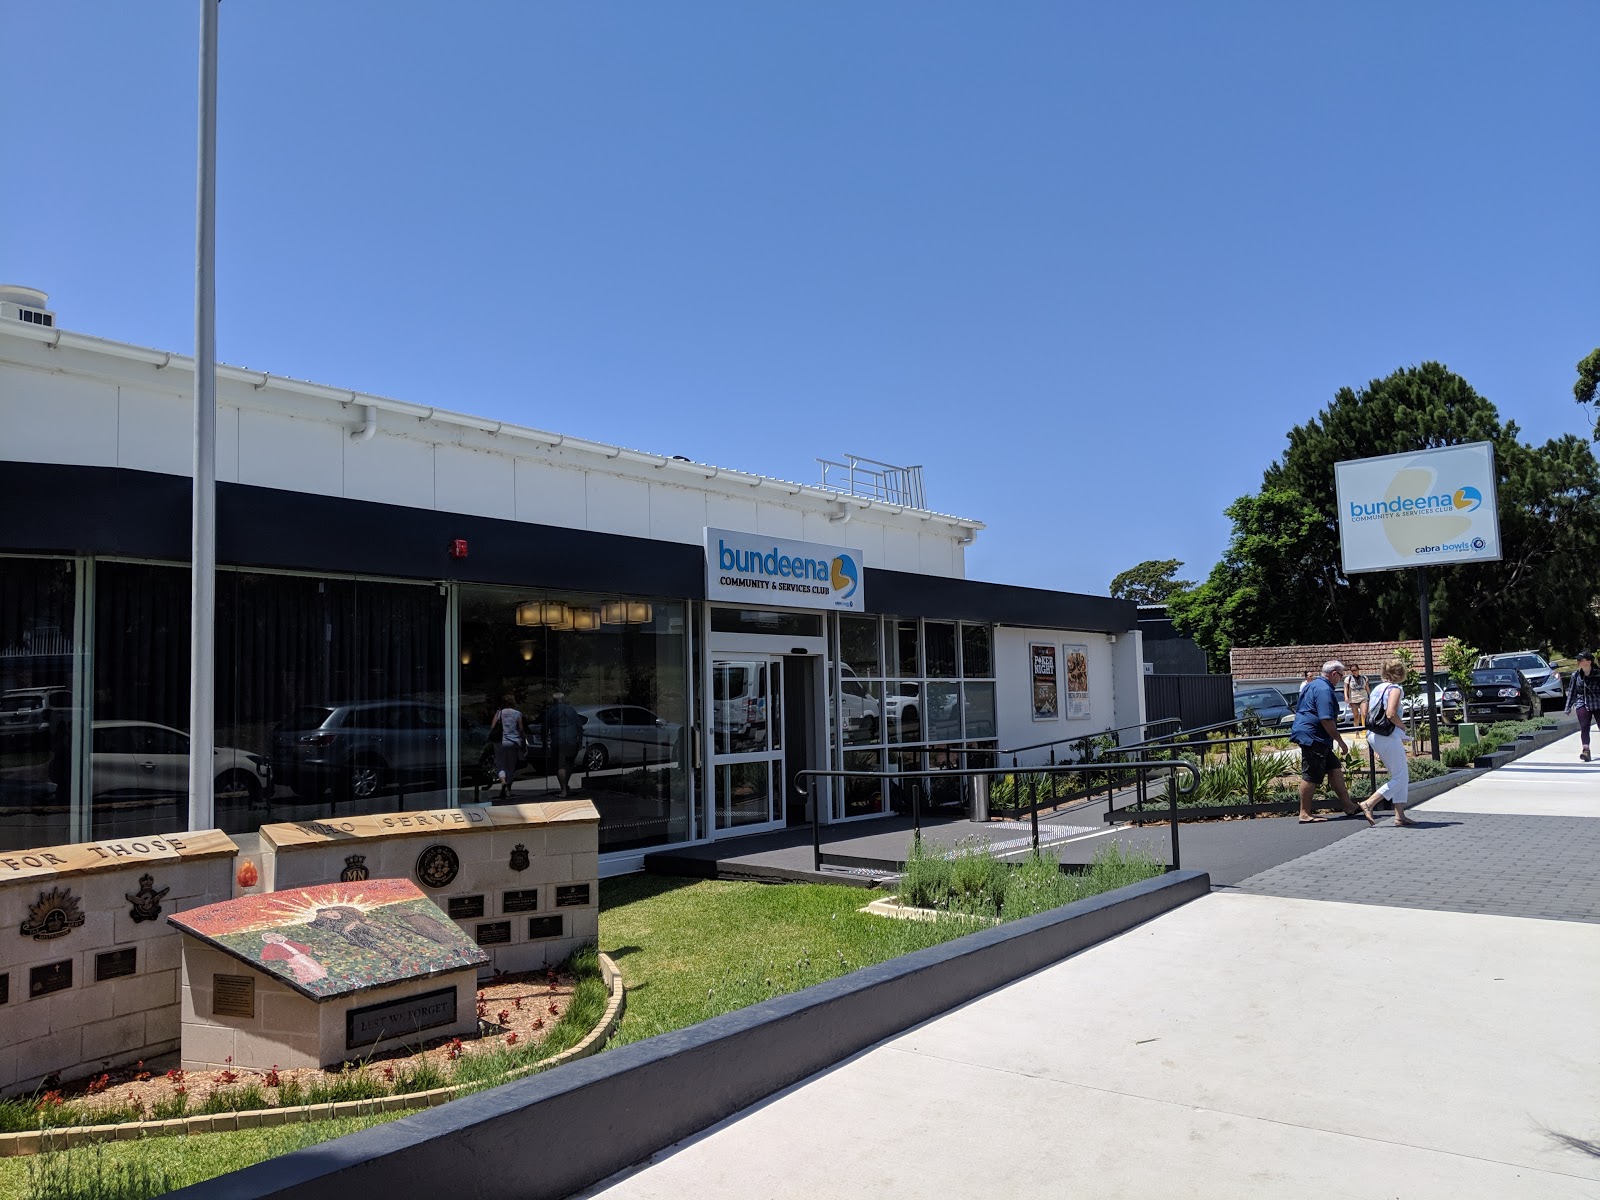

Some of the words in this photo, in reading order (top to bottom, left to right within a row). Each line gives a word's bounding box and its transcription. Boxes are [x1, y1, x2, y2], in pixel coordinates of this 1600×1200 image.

[1350, 494, 1453, 517] bundeena
[1351, 512, 1394, 523] COMMUNITY
[1402, 508, 1434, 517] SERVICES
[1435, 506, 1453, 514] CLUB
[1415, 545, 1441, 554] cabra
[1442, 541, 1470, 551] bowls
[718, 539, 829, 582] bundeena
[720, 576, 770, 590] COMMUNITY
[771, 582, 777, 590] &
[778, 582, 811, 594] SERVICES
[812, 586, 830, 595] CLUB
[1034, 664, 1054, 675] NIGHT
[296, 821, 356, 837] WHO
[382, 810, 484, 829] SERVED
[1, 852, 68, 871] FOR
[87, 838, 188, 859] THOSE
[346, 869, 366, 881] MN
[361, 1016, 387, 1032] LEST
[408, 1002, 448, 1019] FORGET
